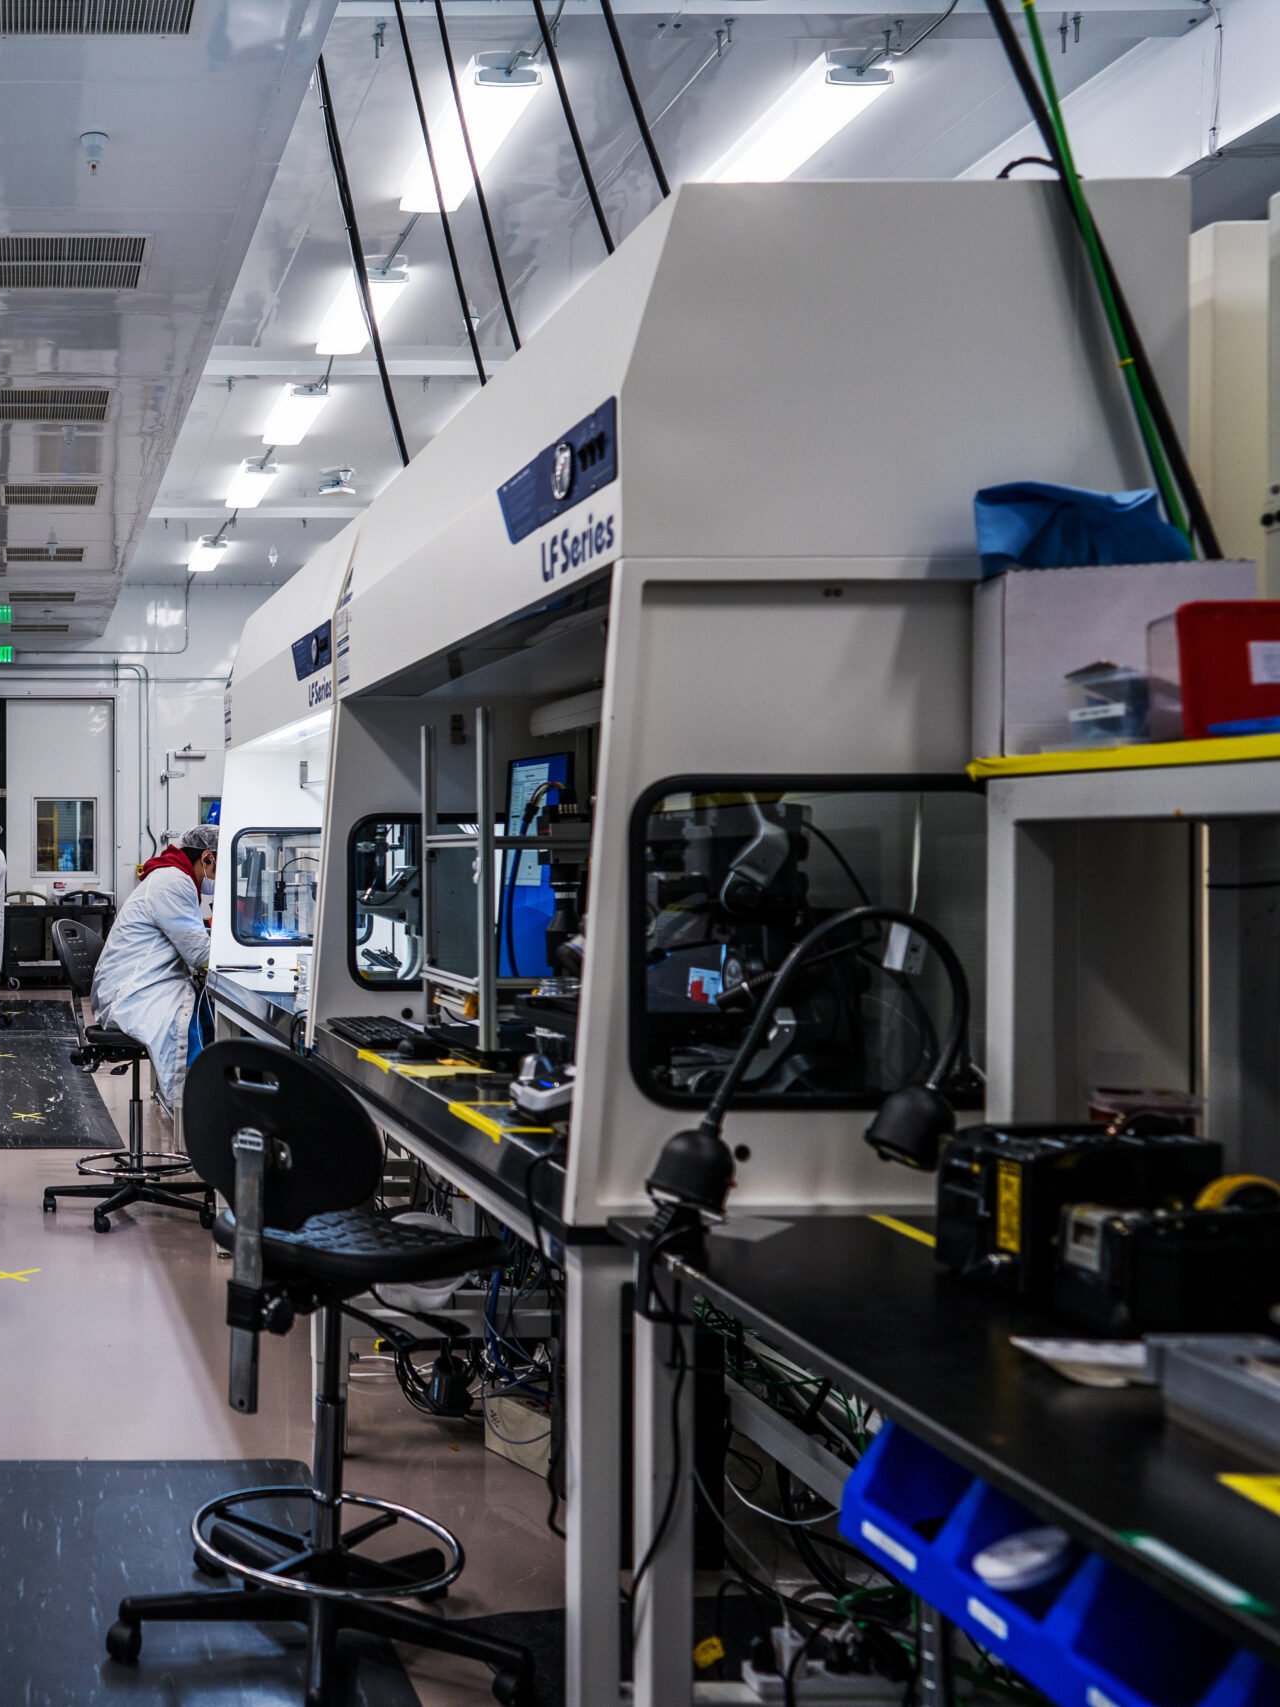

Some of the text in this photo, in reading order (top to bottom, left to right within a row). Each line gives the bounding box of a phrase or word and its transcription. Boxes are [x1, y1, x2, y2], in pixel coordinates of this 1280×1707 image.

[541, 513, 614, 583] LF Series
[315, 676, 332, 705] Series
